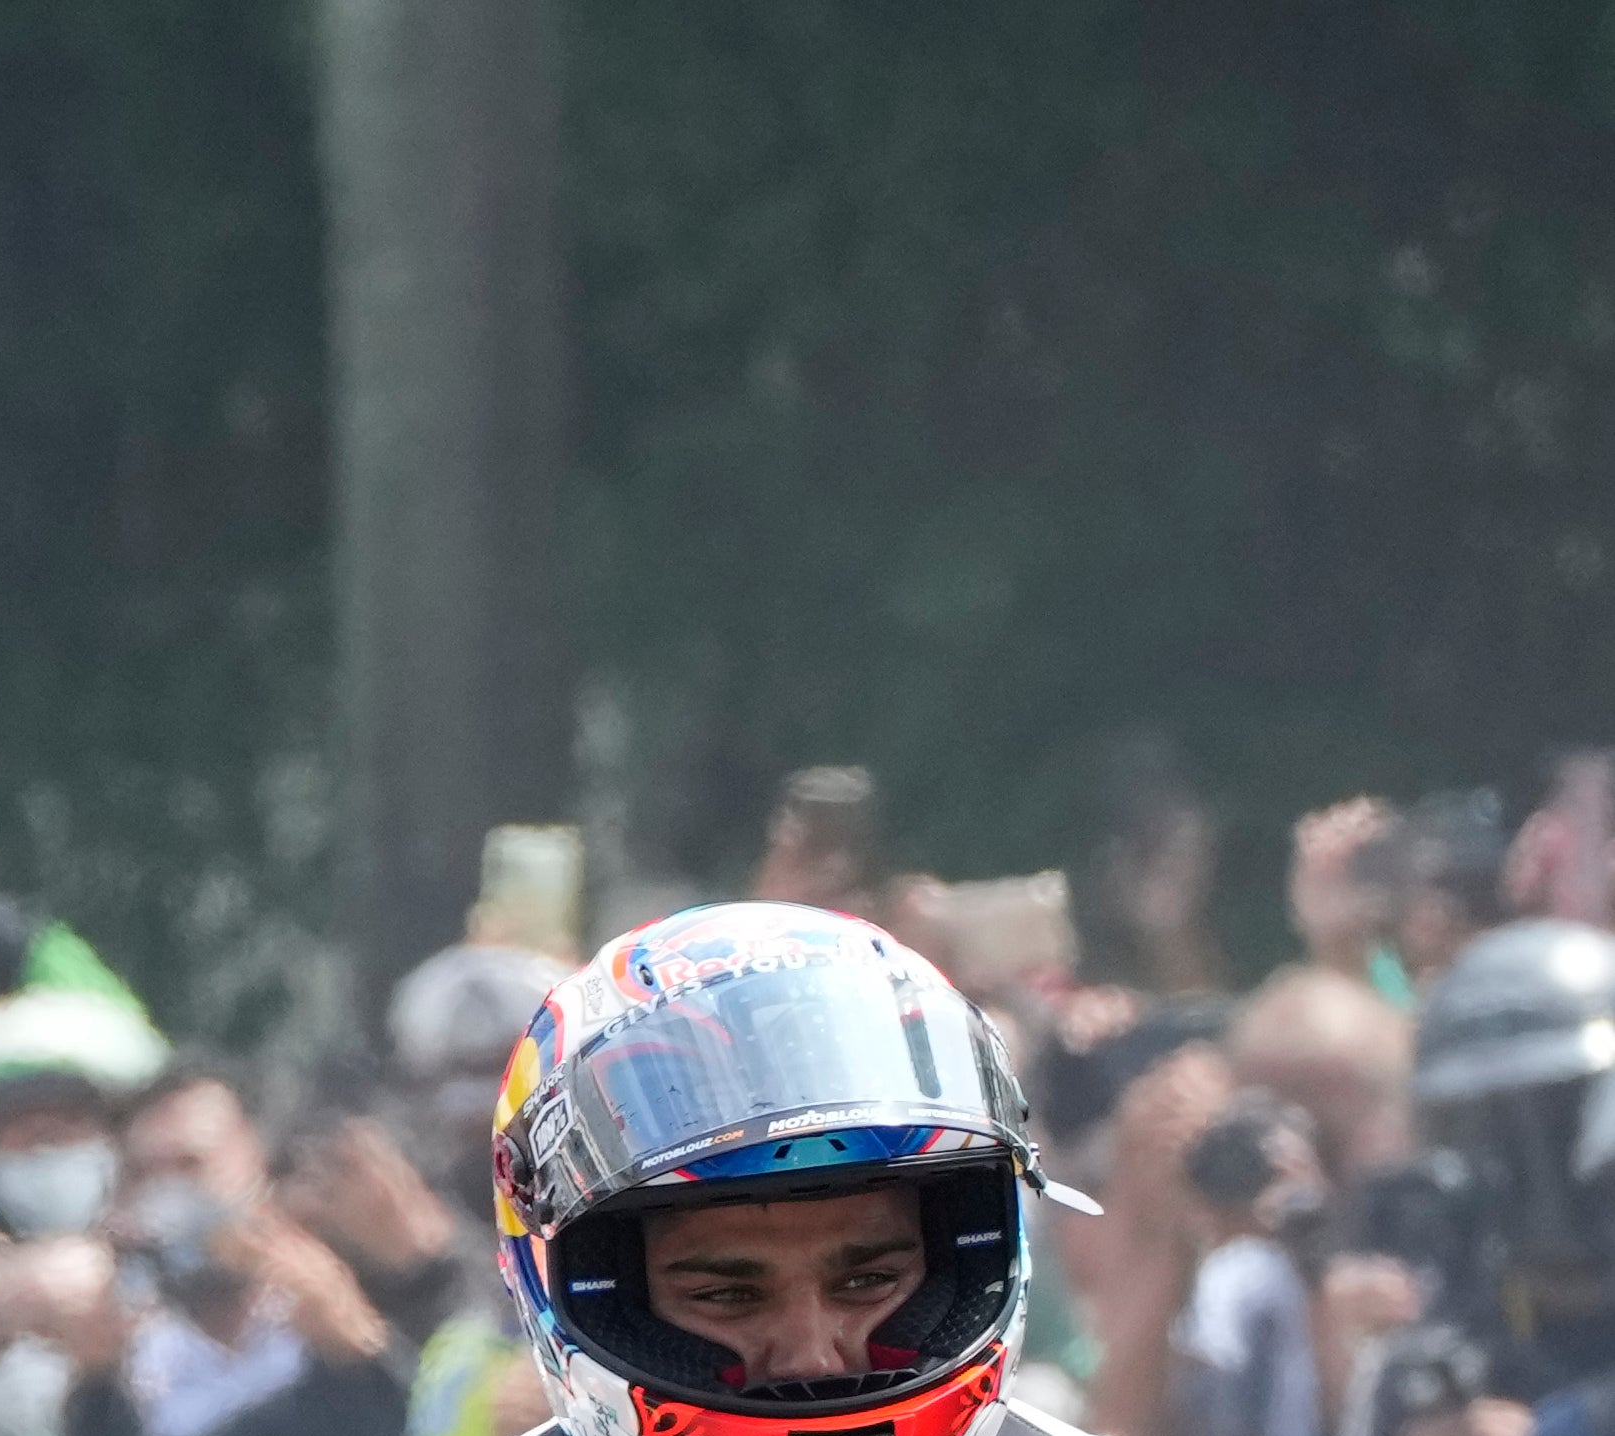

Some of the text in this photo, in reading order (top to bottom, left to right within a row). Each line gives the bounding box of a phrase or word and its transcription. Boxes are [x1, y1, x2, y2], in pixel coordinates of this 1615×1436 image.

[729, 952, 805, 980] YOU
[640, 1129, 744, 1170] MOTOBLOUZ.COM
[957, 1231, 1002, 1245] SHARK
[571, 1278, 616, 1292] SHARK
